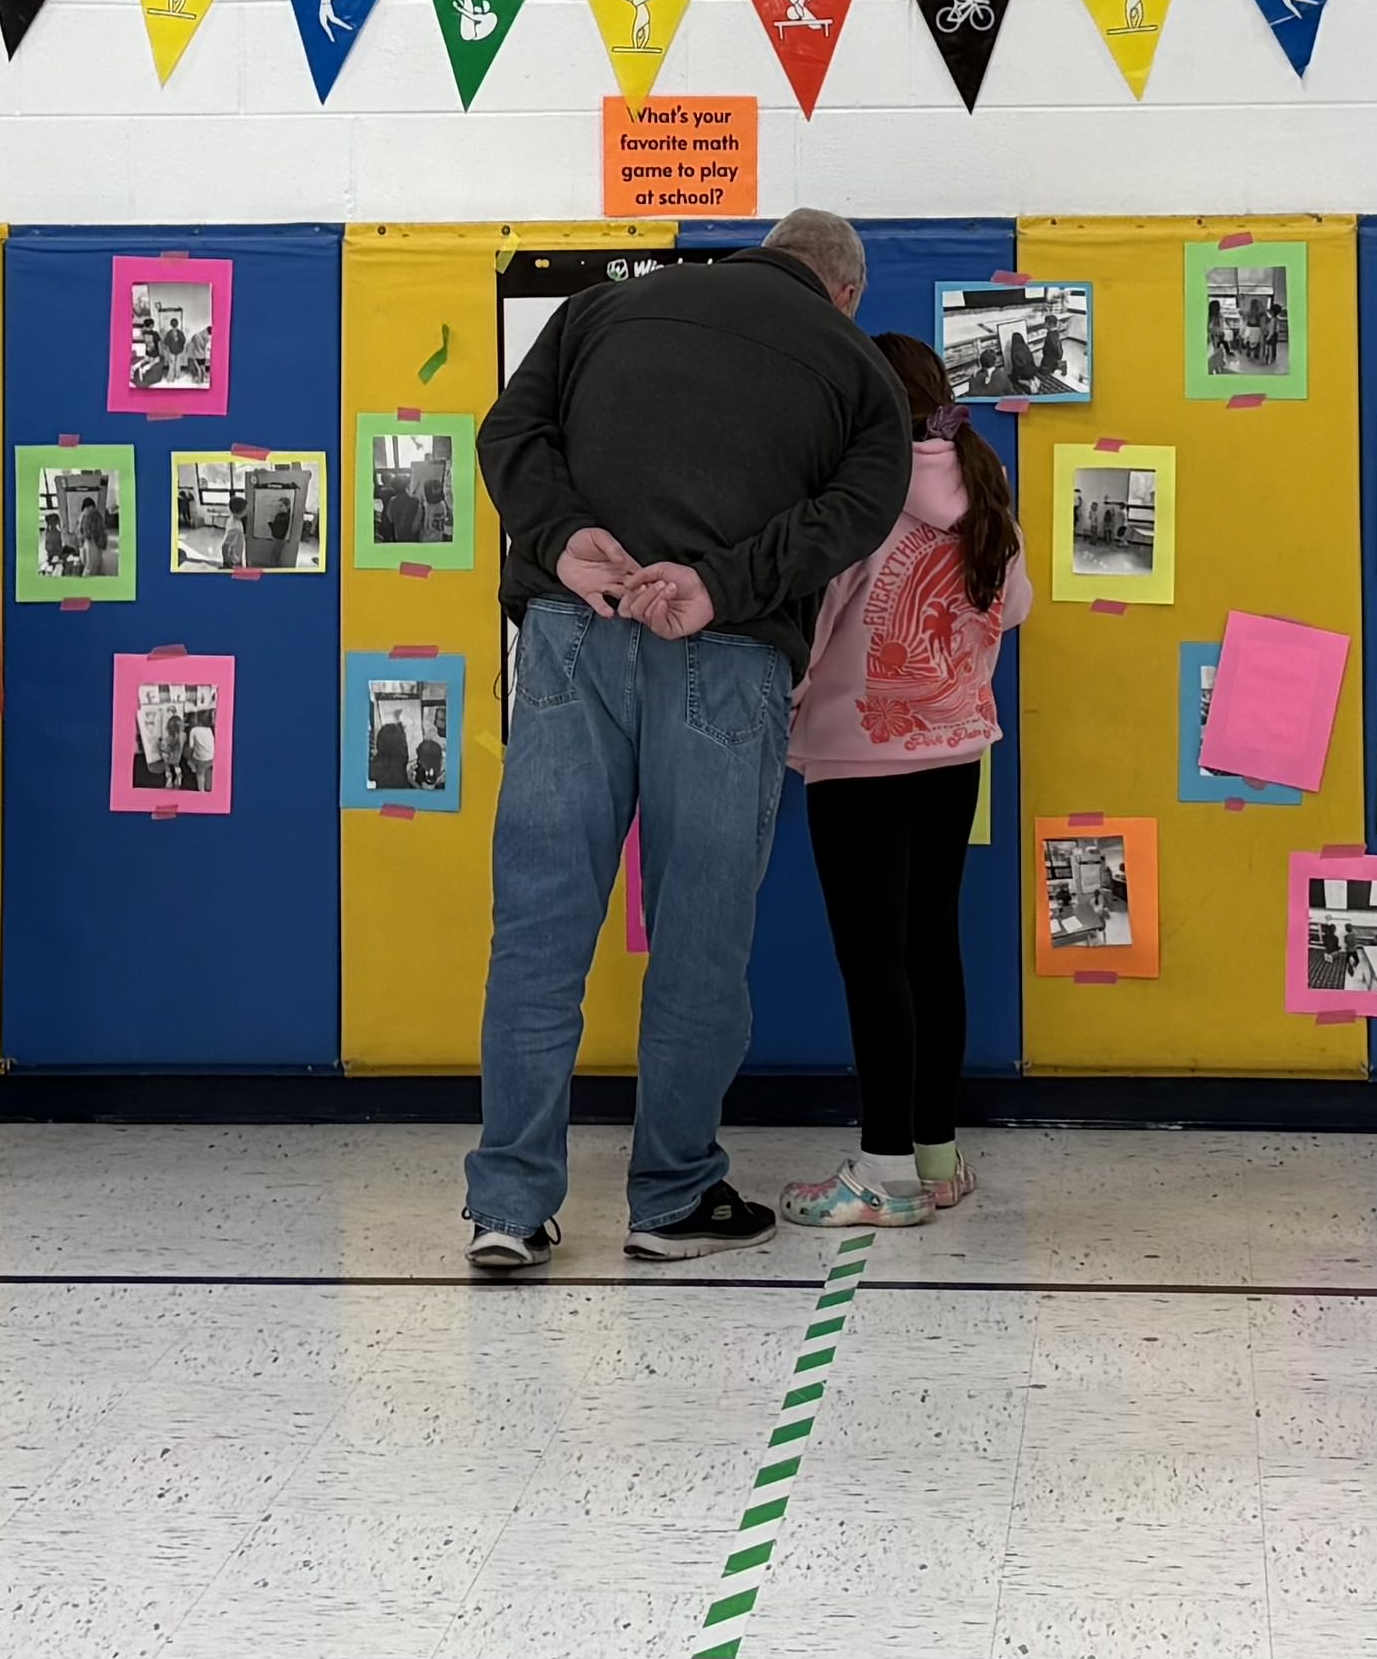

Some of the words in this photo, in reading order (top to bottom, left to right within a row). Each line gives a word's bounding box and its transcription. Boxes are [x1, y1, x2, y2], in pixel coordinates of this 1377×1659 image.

[626, 104, 688, 124] What's
[693, 111, 732, 128] your
[620, 133, 688, 151] favorite
[693, 134, 739, 151] math
[622, 166, 672, 182] game
[678, 162, 695, 178] to
[700, 161, 739, 182] play
[635, 190, 655, 205] at
[658, 188, 724, 205] school?
[863, 523, 937, 627] EVERYTHING
